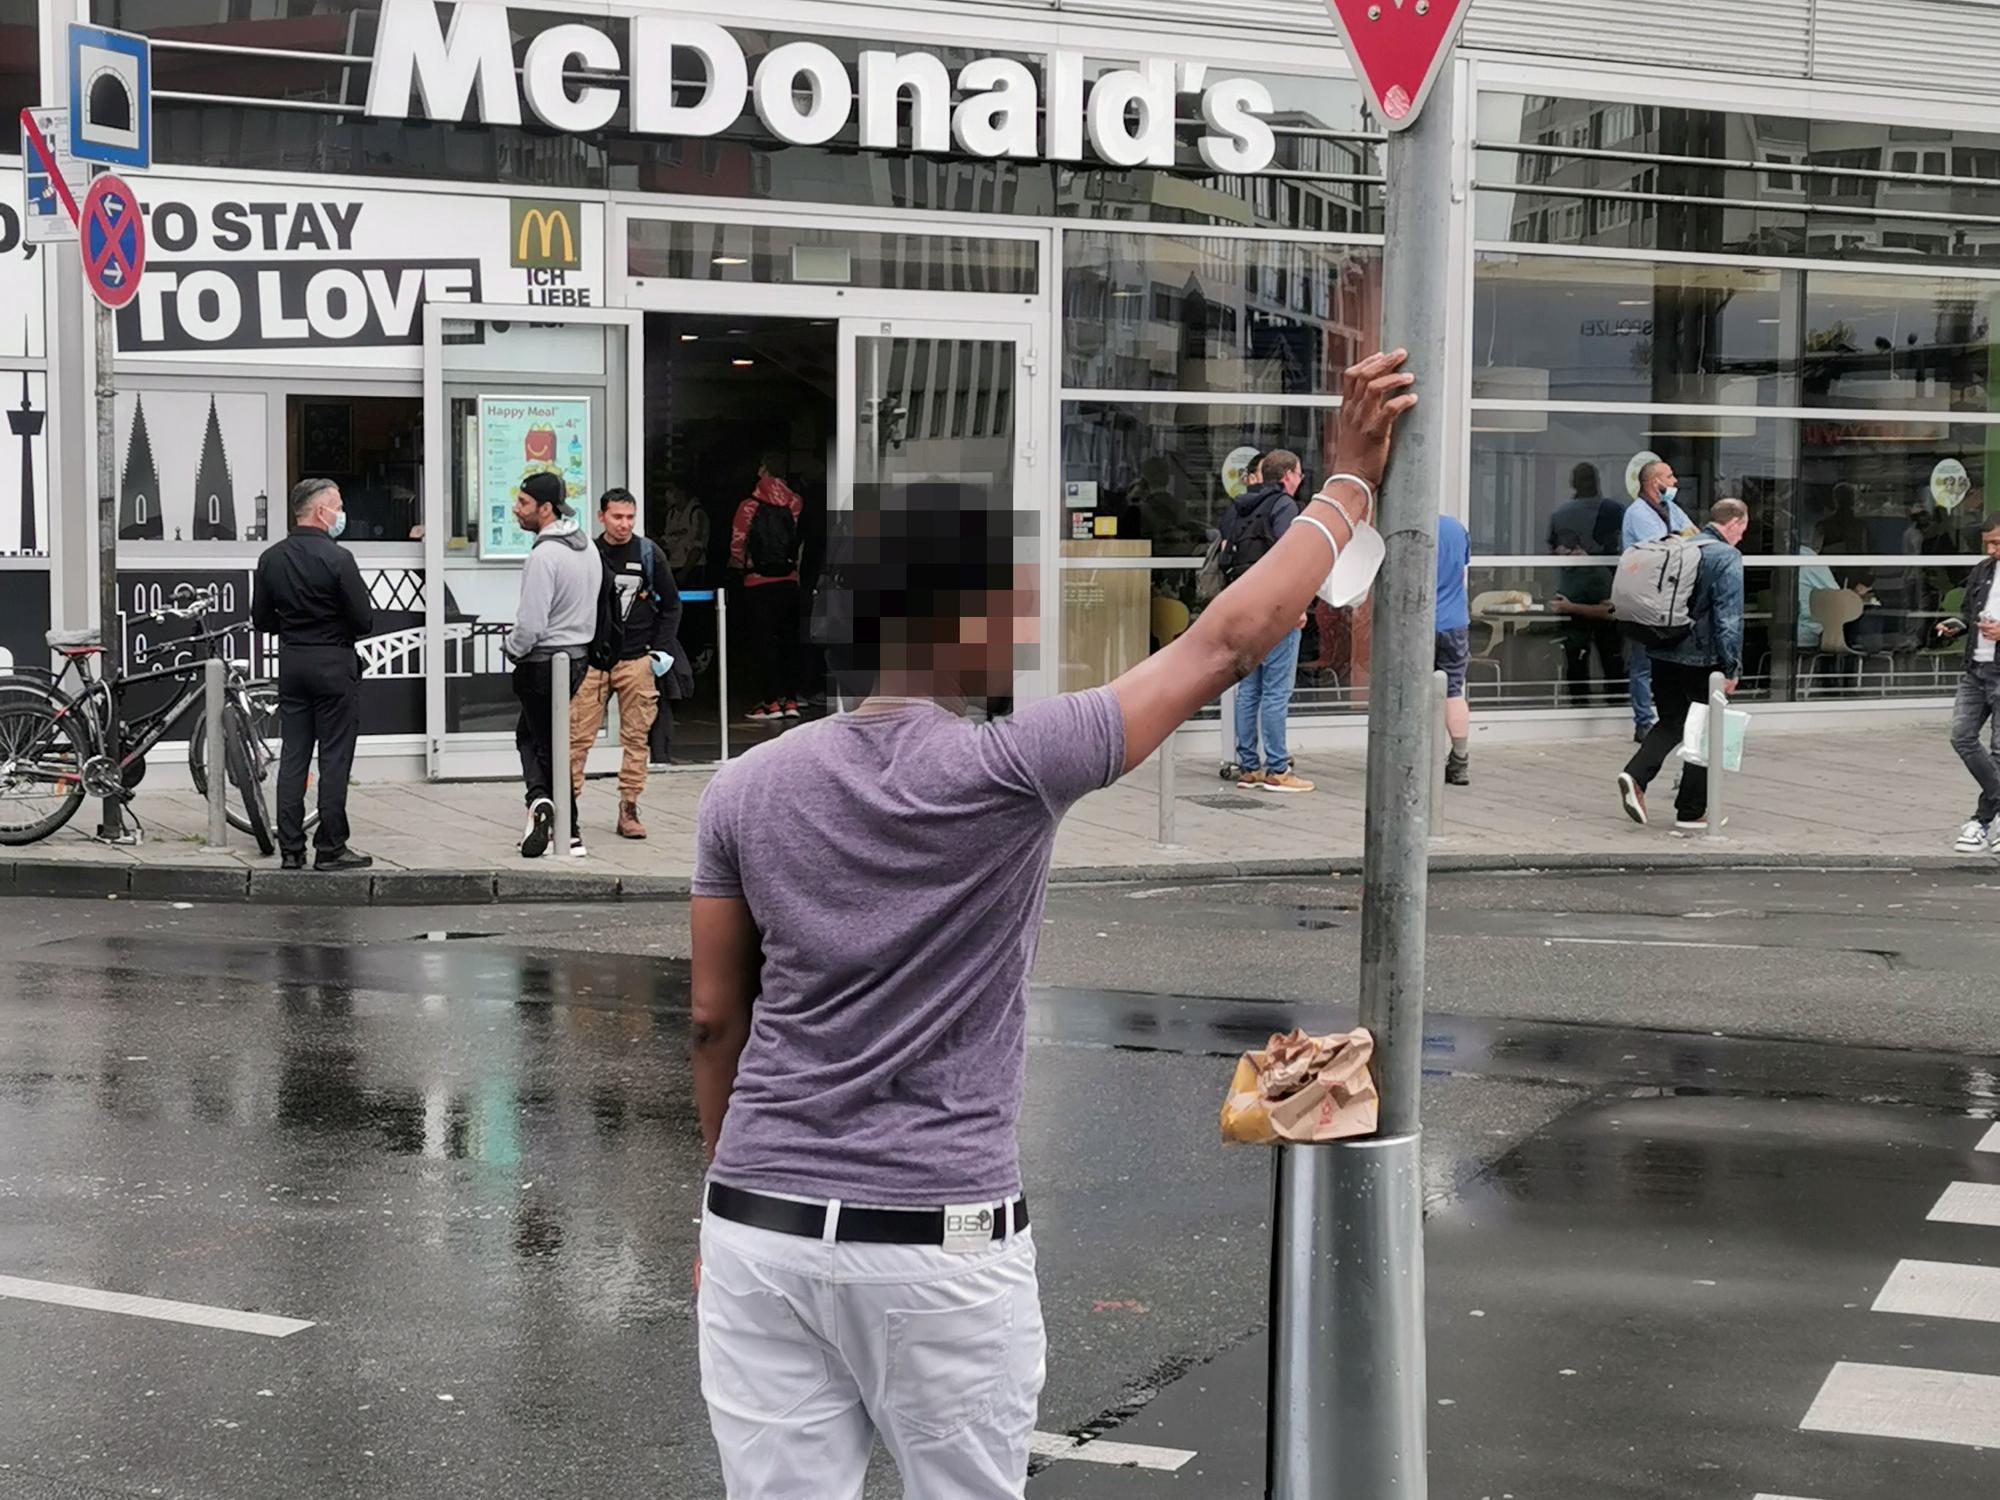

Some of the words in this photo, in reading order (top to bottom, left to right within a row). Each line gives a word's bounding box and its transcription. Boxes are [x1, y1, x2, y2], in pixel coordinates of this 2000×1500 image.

[366, 0, 1277, 175] McDonald's
[140, 201, 198, 252] O
[211, 201, 363, 252] STAY
[527, 268, 566, 286] ICH
[138, 269, 242, 342] TO
[528, 288, 591, 307] LIEBE
[487, 405, 525, 419] Happy
